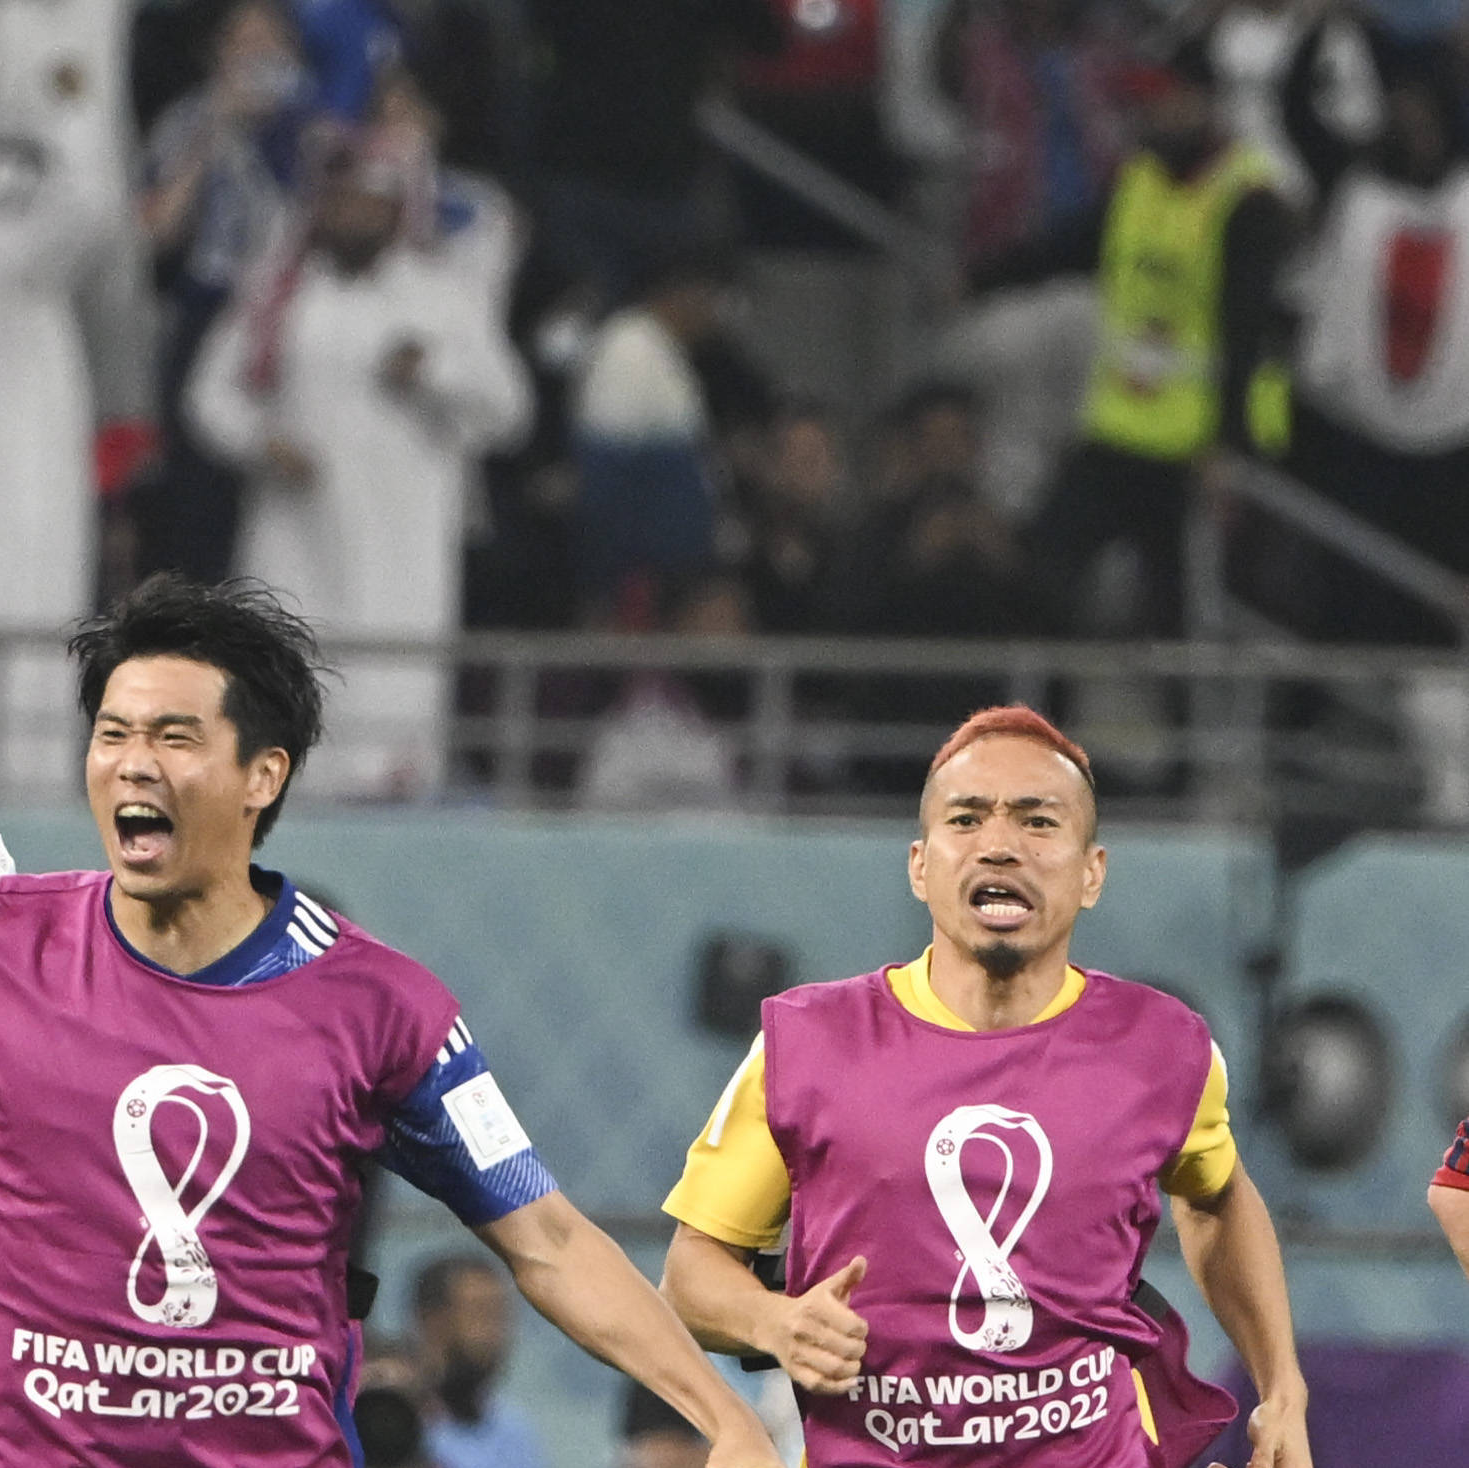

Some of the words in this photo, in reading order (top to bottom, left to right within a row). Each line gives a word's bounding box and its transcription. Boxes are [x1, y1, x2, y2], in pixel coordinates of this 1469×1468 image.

[11, 1328, 90, 1372] FIFA
[93, 1343, 246, 1379] WORLD
[251, 1343, 317, 1377] CUP
[847, 1375, 923, 1405] FIFA
[924, 1367, 1064, 1405] WORLD
[1069, 1345, 1116, 1388] CUP
